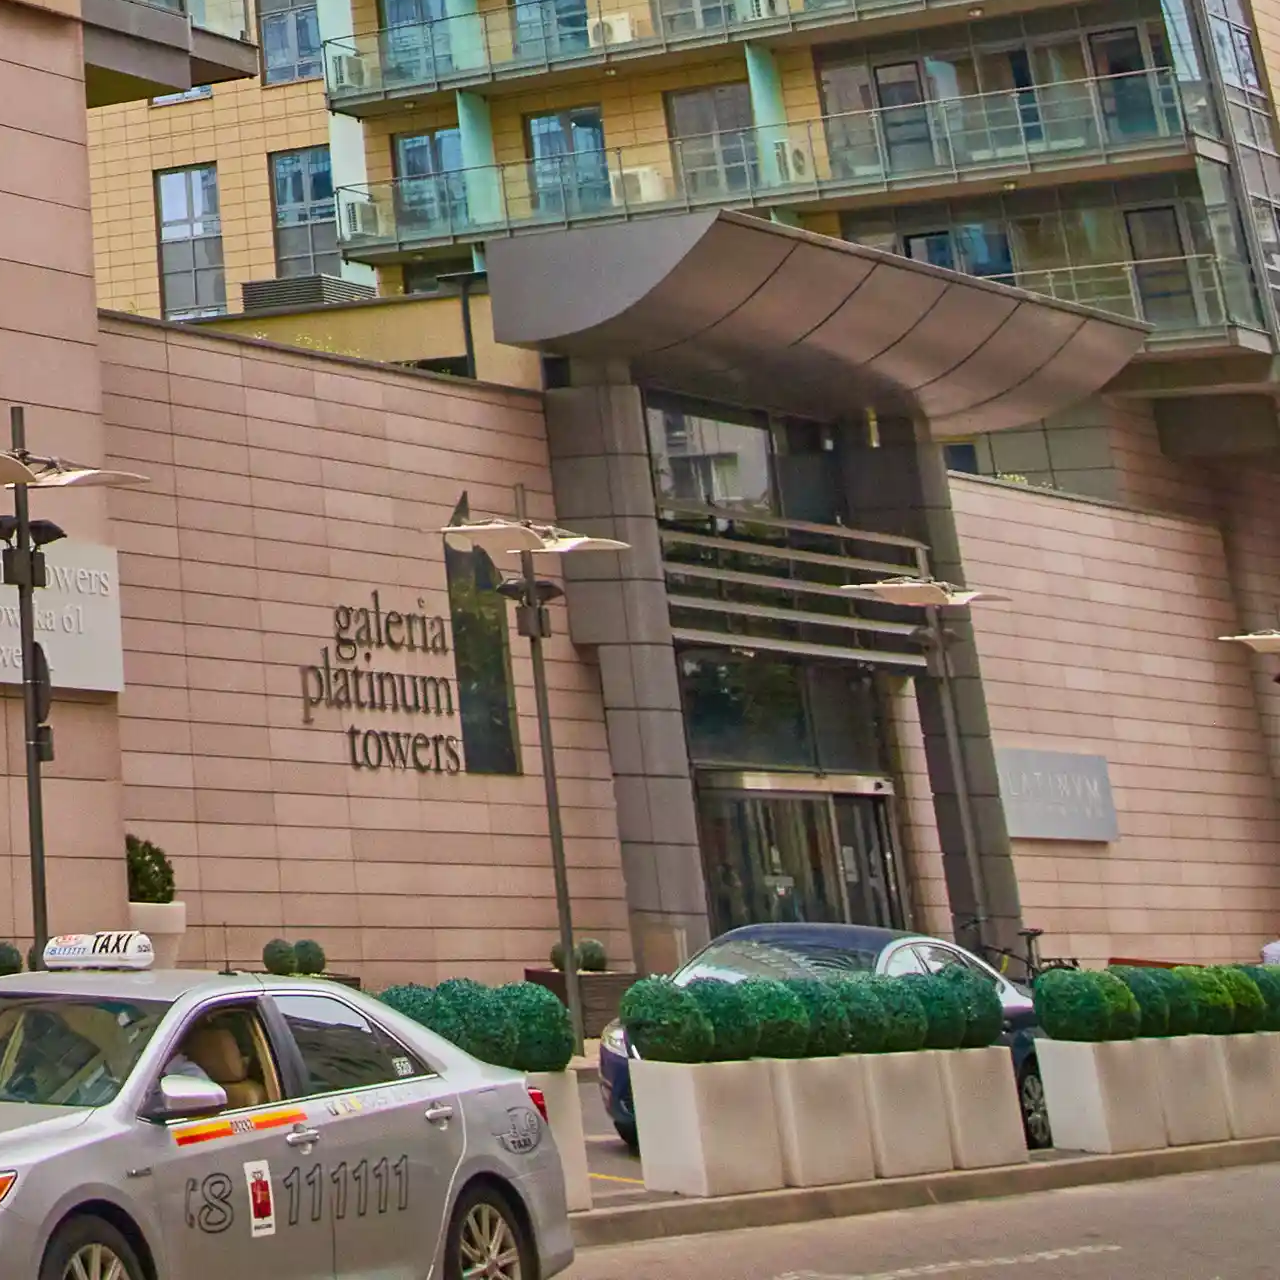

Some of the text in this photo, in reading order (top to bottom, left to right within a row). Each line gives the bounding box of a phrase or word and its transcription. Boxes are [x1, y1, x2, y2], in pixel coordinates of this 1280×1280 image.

[44, 564, 110, 596] owers
[61, 603, 85, 635] 61
[333, 590, 449, 661] galeria
[299, 646, 455, 725] platinum
[347, 724, 462, 776] towers
[91, 933, 134, 955] TAXI
[282, 1154, 409, 1226] 111111
